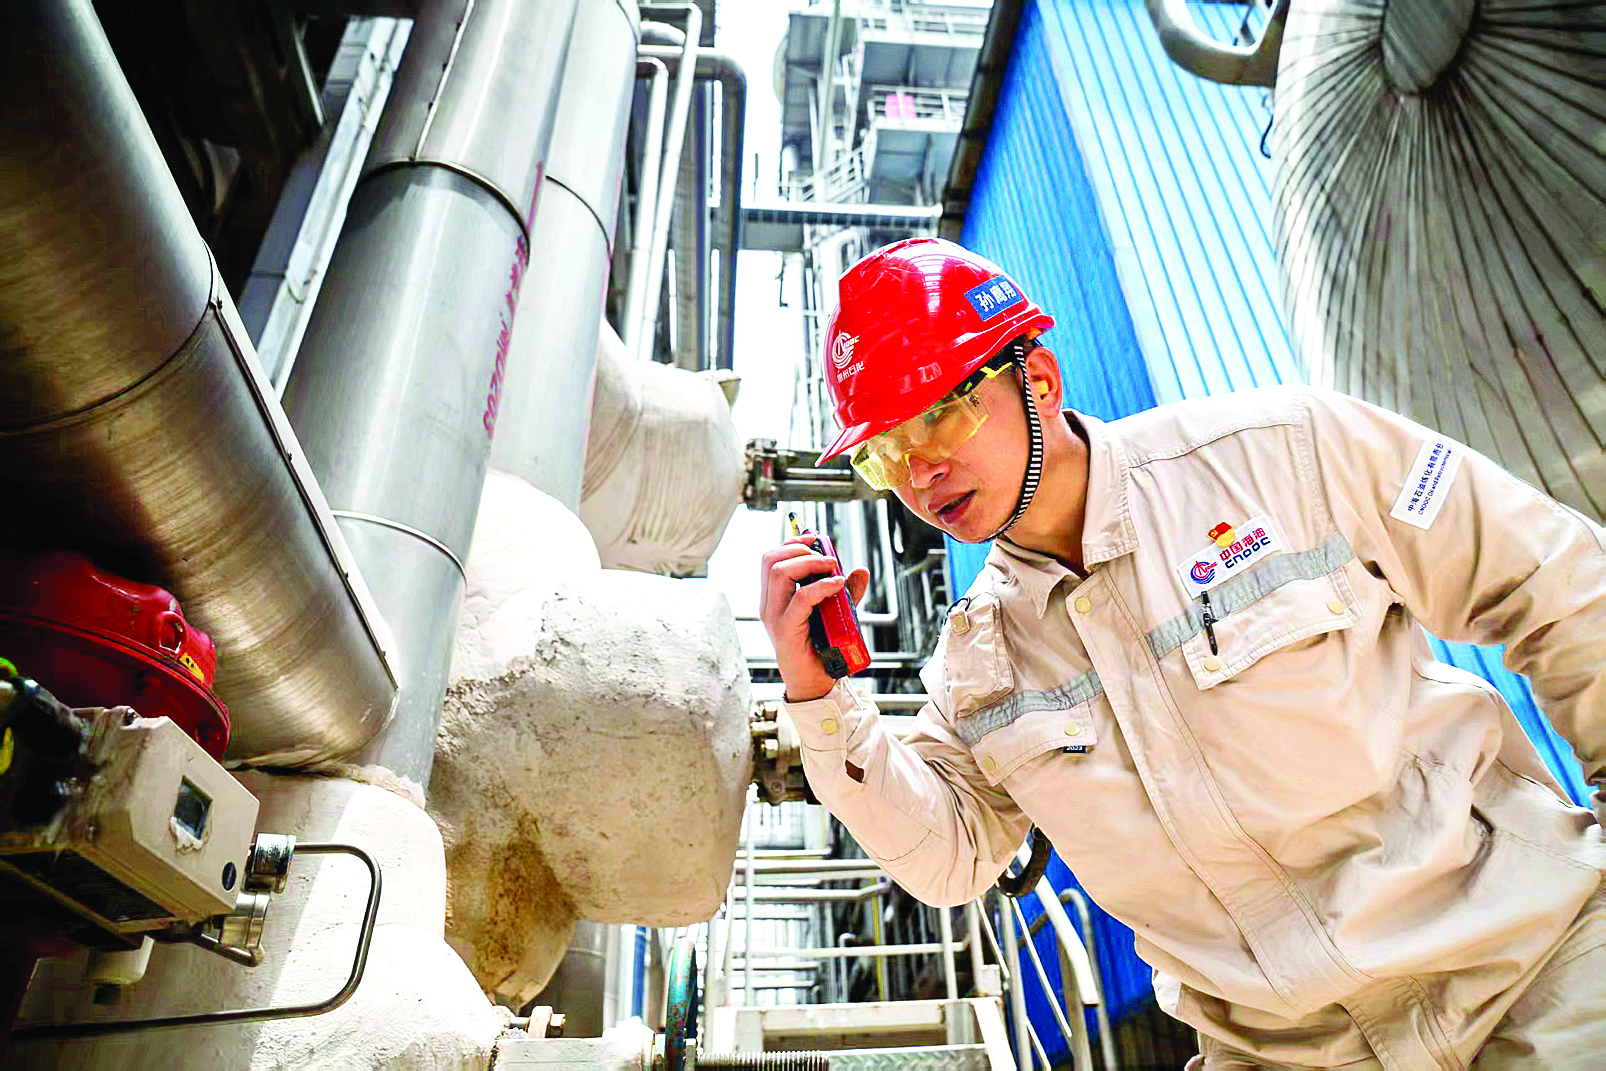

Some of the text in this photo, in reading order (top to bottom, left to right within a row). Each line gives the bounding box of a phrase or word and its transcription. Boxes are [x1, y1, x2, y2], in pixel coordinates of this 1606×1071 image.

[1418, 496, 1431, 515] CNOOC
[1219, 527, 1266, 561] 中国海油
